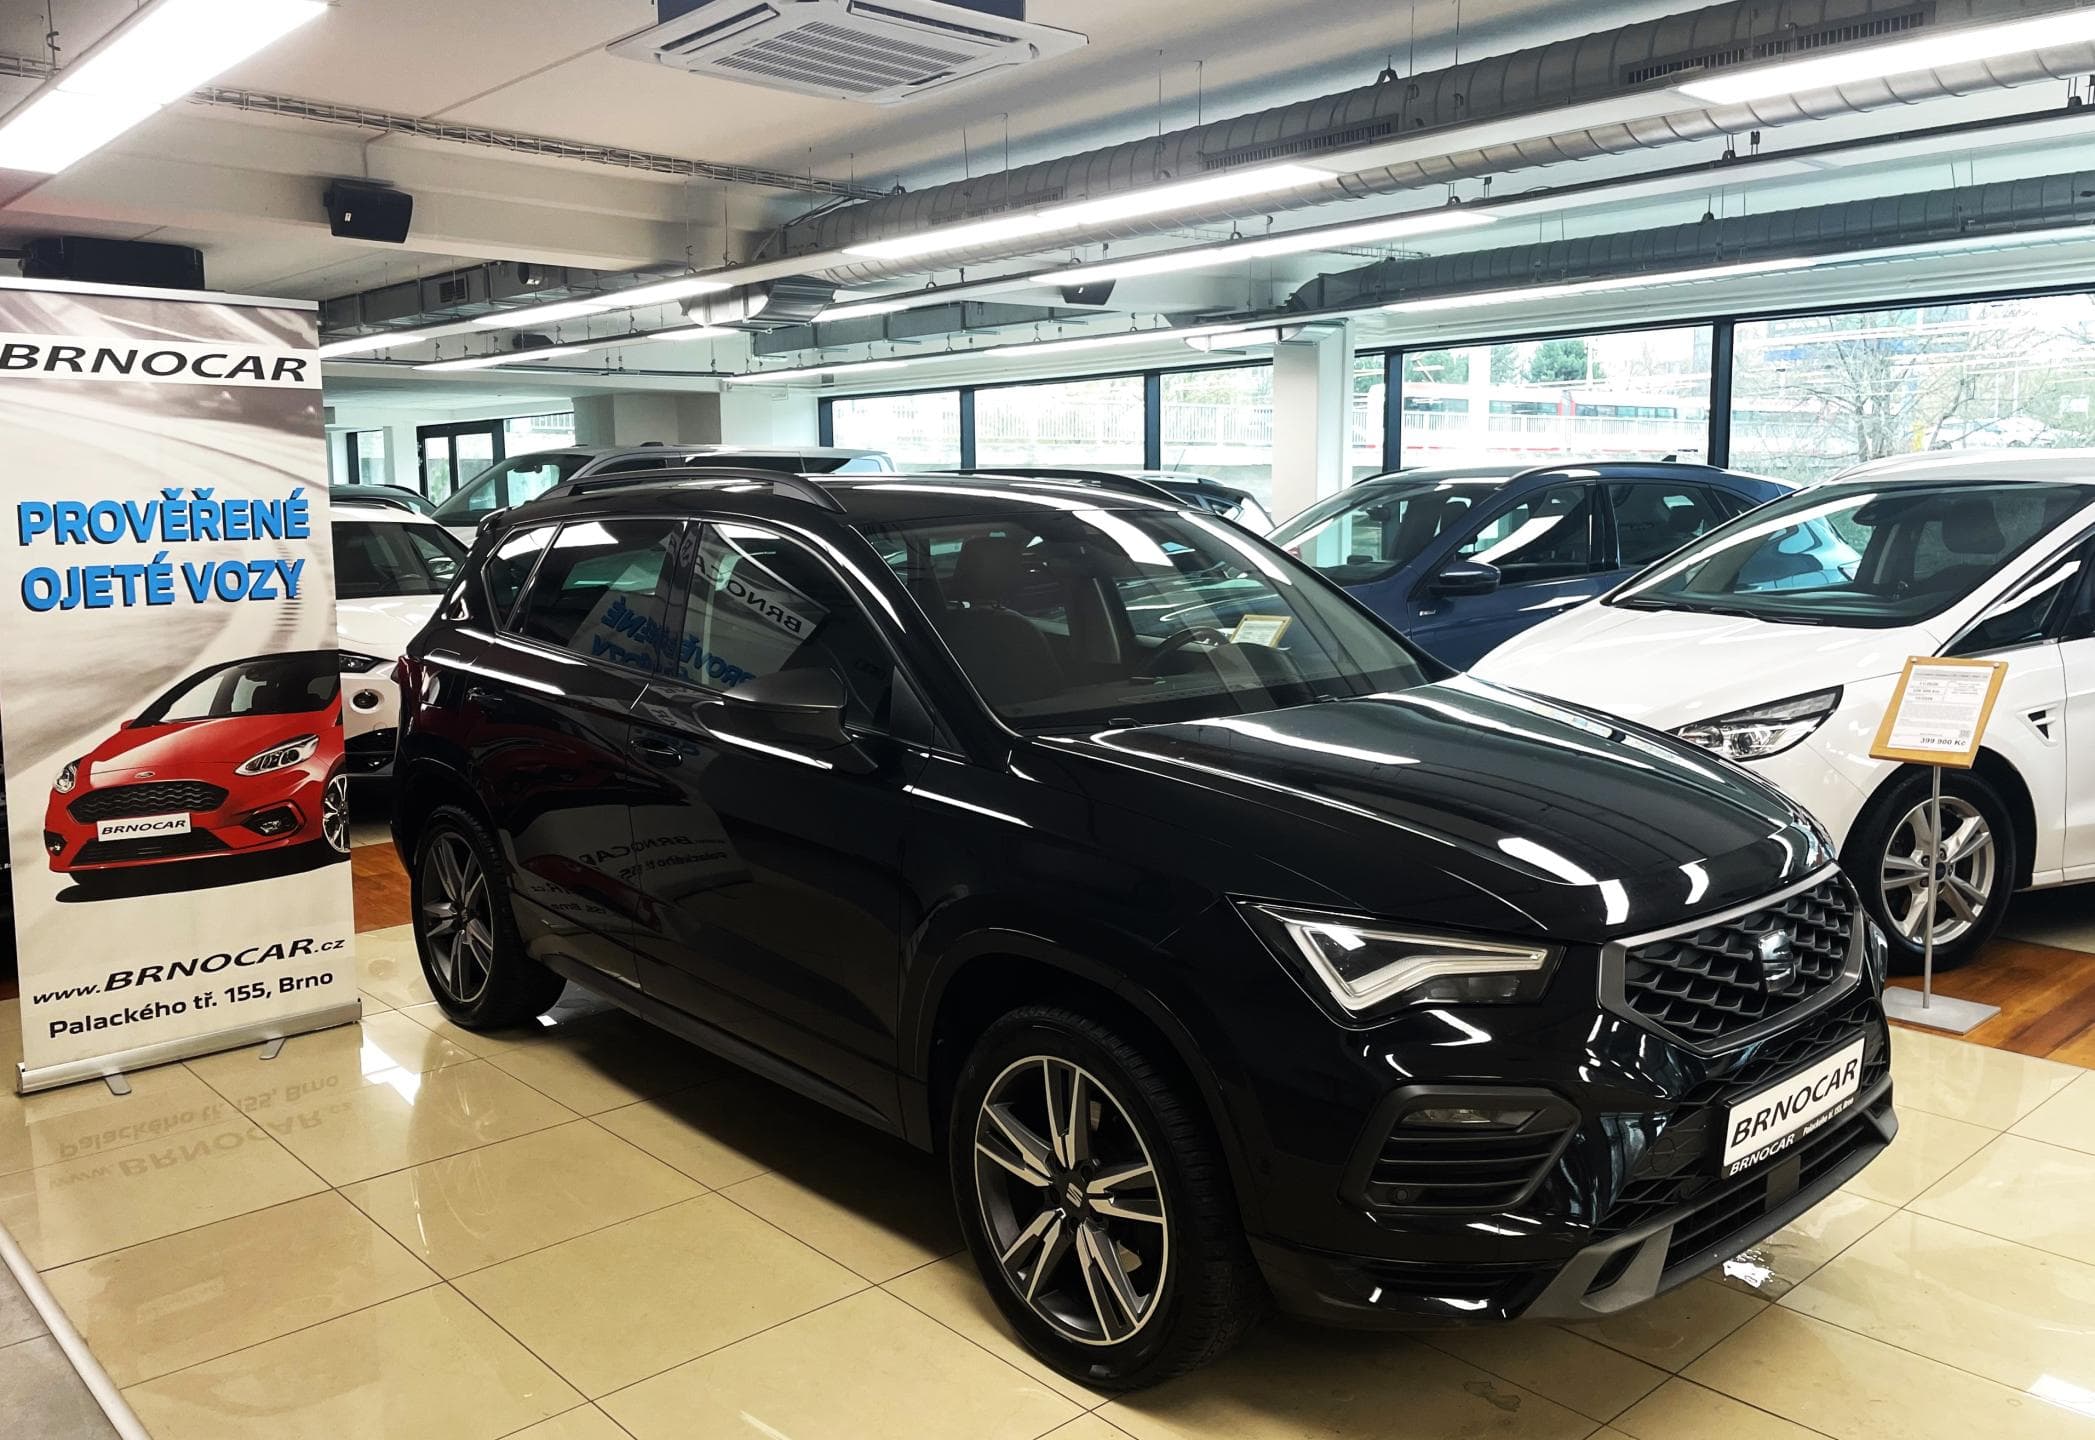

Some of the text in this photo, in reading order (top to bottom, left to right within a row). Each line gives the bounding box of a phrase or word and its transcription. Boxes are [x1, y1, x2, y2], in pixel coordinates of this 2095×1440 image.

[0, 343, 307, 382] BRNOCAR
[17, 487, 310, 546] PROVĚŘENÉ
[21, 551, 305, 612] OJETÉ VOZY
[101, 819, 186, 835] BRNOCAR
[33, 937, 345, 1006] www.BRNOCAR.cz
[49, 970, 333, 1038] Palackého tř. 155, Brno
[1730, 1058, 1858, 1148] BRNOCAR
[1729, 1133, 1796, 1177] BRNOCAR
